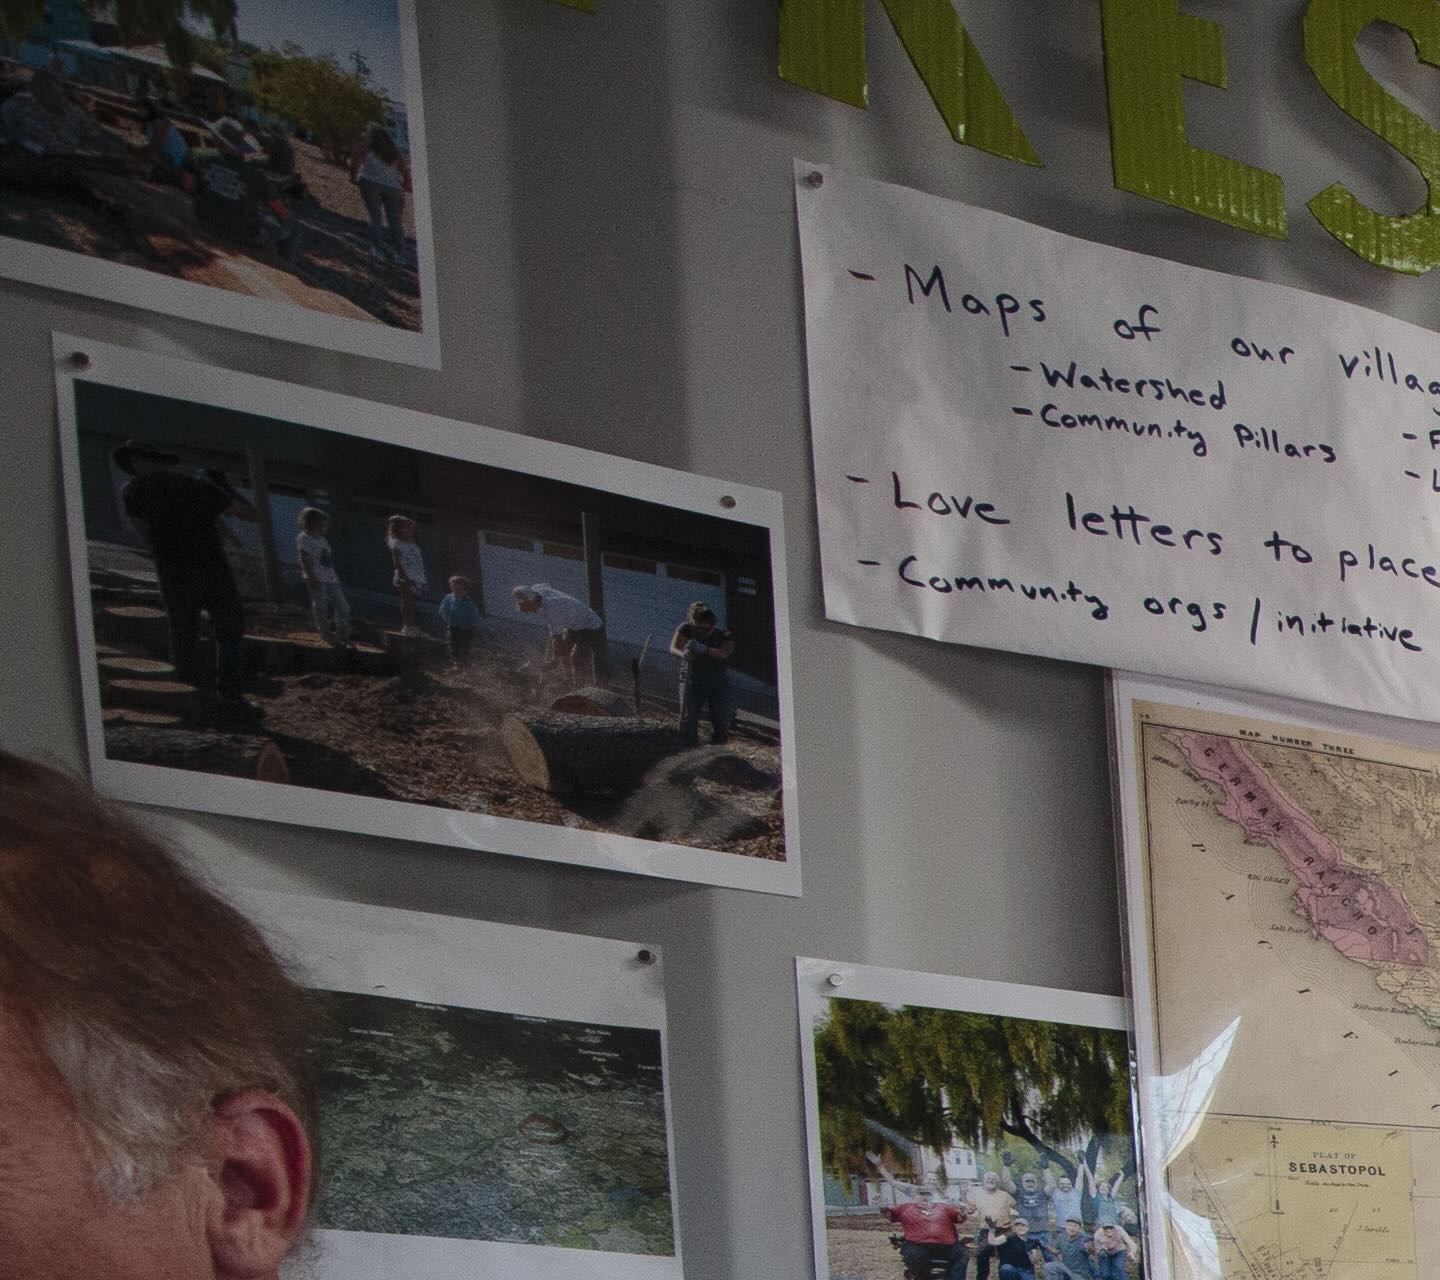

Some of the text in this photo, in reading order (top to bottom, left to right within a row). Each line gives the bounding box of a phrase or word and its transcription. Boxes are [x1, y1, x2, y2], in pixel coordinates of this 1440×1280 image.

[903, 264, 1047, 338] Maps
[1113, 304, 1161, 341] of
[1231, 336, 1296, 366] our
[1039, 361, 1227, 411] Watershed
[1039, 403, 1337, 464] Community Pillars
[891, 470, 1011, 526] Love
[1064, 491, 1223, 557] letters
[1262, 529, 1314, 565] to
[897, 554, 1110, 622] Community
[1143, 594, 1228, 633] orgs
[1276, 608, 1423, 653] initiative
[1288, 1161, 1386, 1177] SEBASTOPOL
